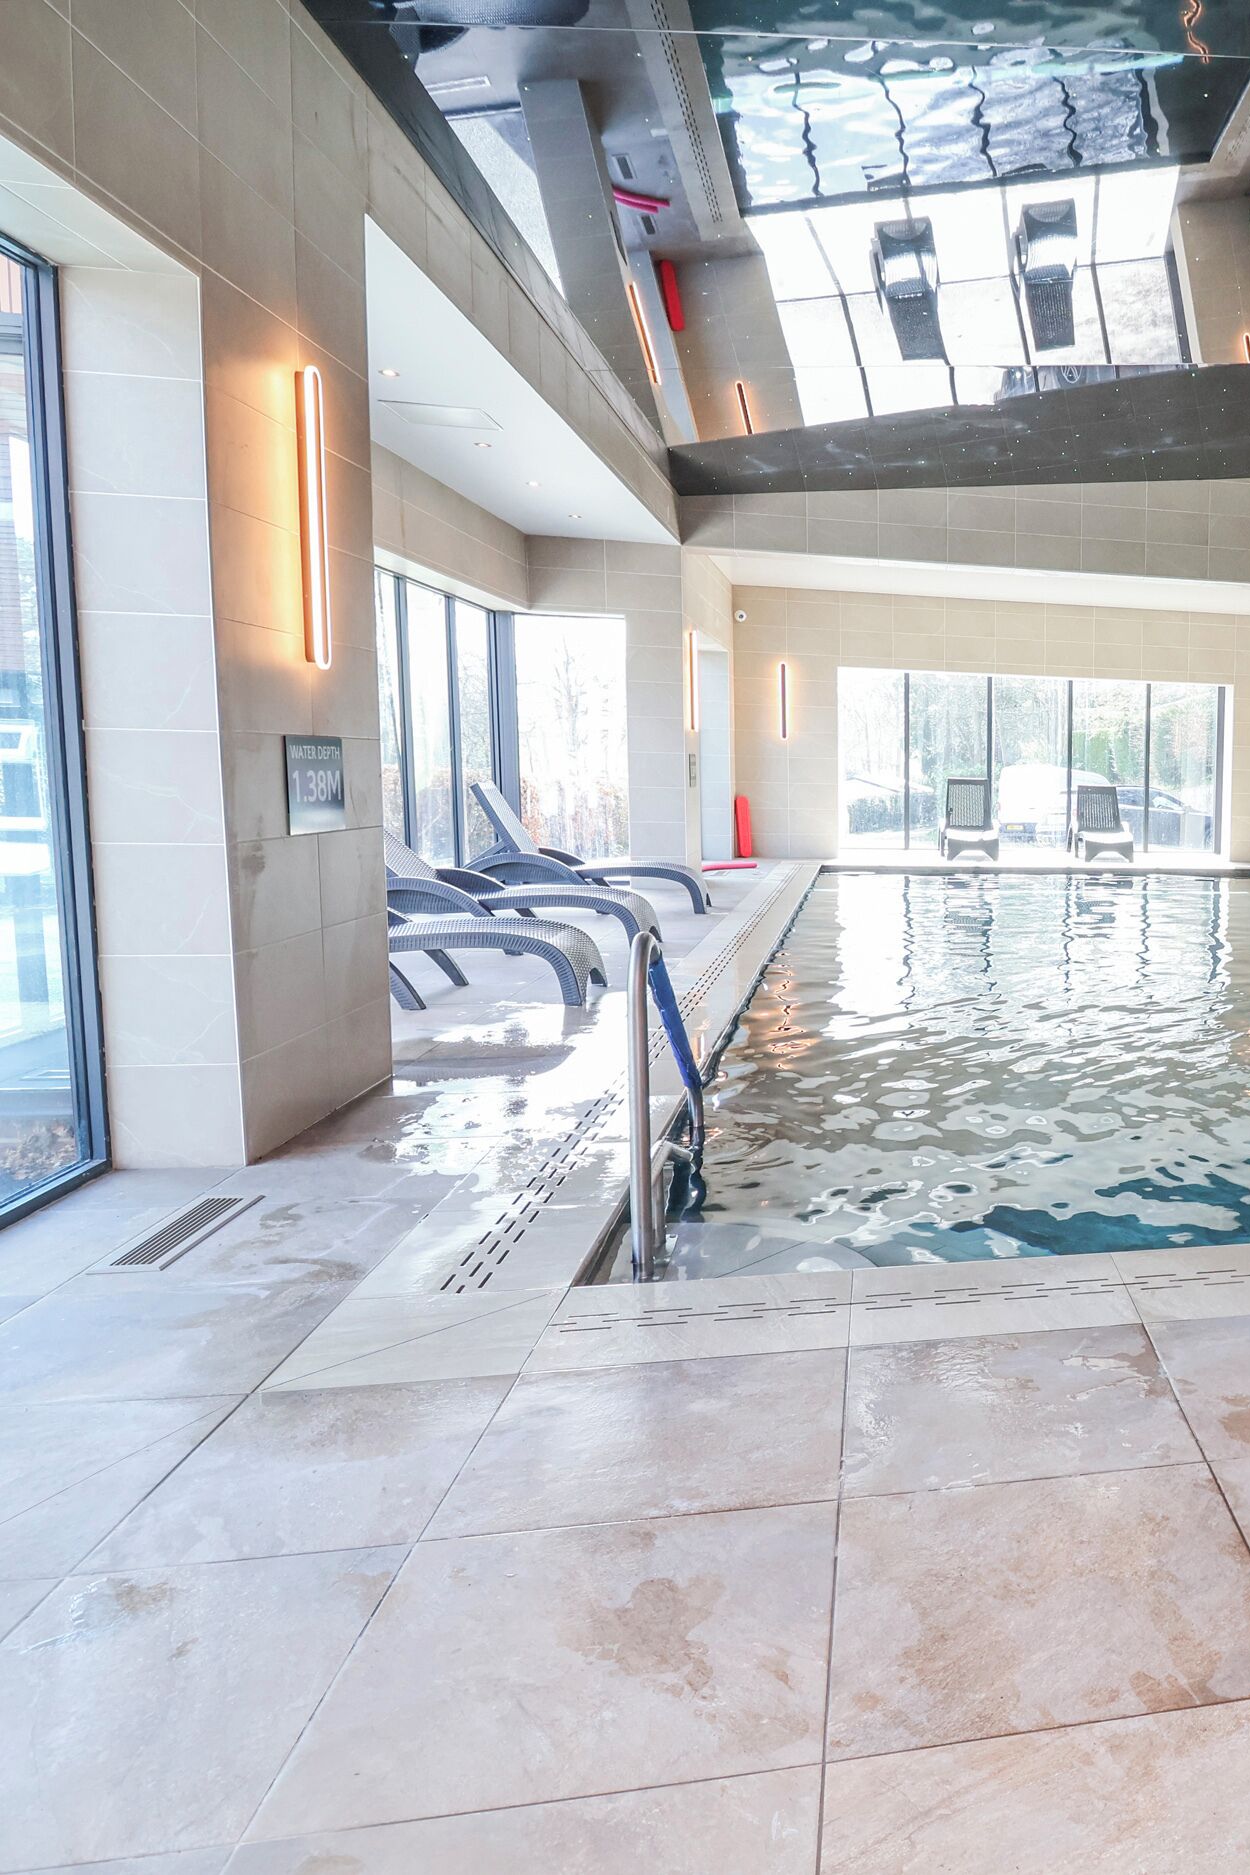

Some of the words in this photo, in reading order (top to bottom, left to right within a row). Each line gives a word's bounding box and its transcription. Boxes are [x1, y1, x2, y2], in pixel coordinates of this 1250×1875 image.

[289, 744, 316, 760] WATER
[317, 746, 341, 760] DEPTH
[292, 769, 342, 803] 1.38M
